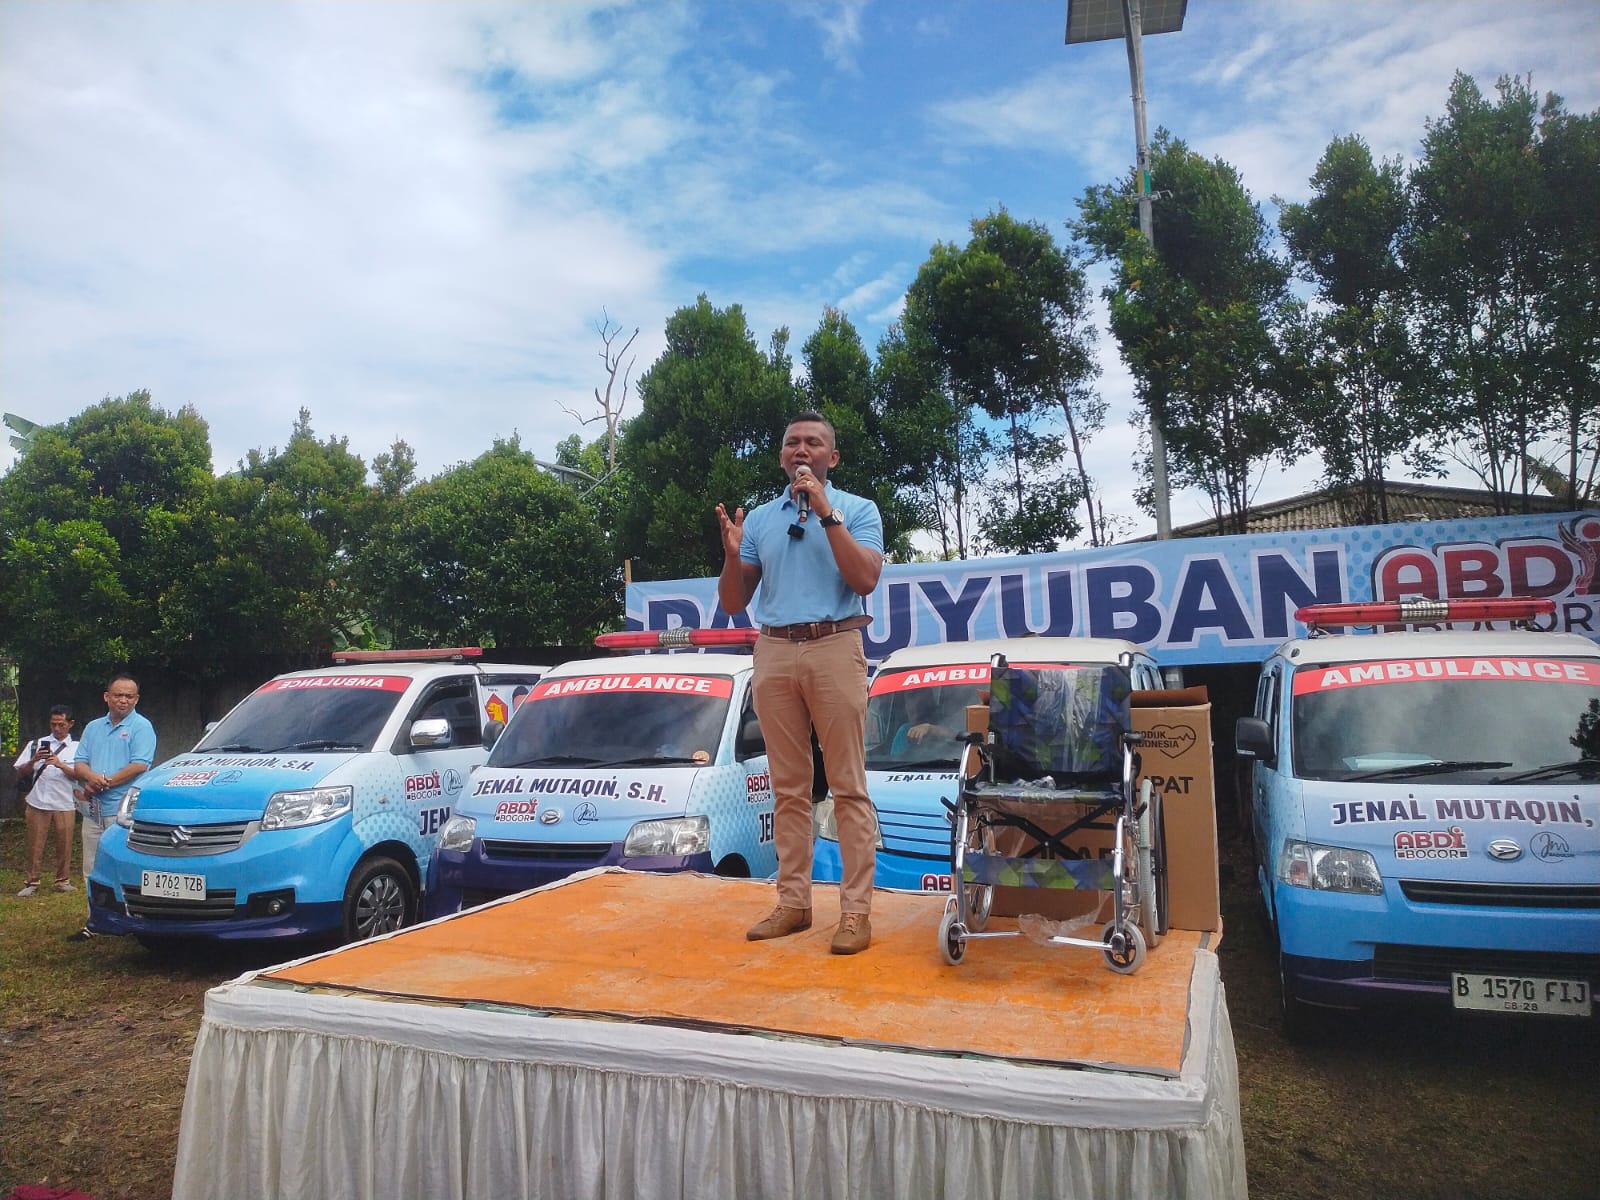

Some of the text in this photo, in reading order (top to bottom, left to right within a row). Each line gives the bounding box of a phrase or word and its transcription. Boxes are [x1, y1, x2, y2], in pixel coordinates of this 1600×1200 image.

[648, 549, 1345, 659] PAUYUBAN
[902, 668, 990, 686] AMBU
[1321, 661, 1590, 686] AMBULANCE
[544, 677, 712, 696] AMBULANCE
[282, 759, 315, 771] S.H.
[885, 774, 933, 782] JENAL
[411, 790, 437, 800] BOGOR
[473, 775, 666, 803] JENAL MUTAQIN, S.H.
[500, 814, 531, 822] BOGOR
[1332, 794, 1593, 827] JENAL MUTAQIN,
[420, 807, 450, 836] JEN
[1406, 850, 1460, 859] BOGOR
[143, 873, 203, 891] B 1762 TZB
[921, 873, 951, 891] AB
[1456, 976, 1585, 1003] B 1570 FIJ
